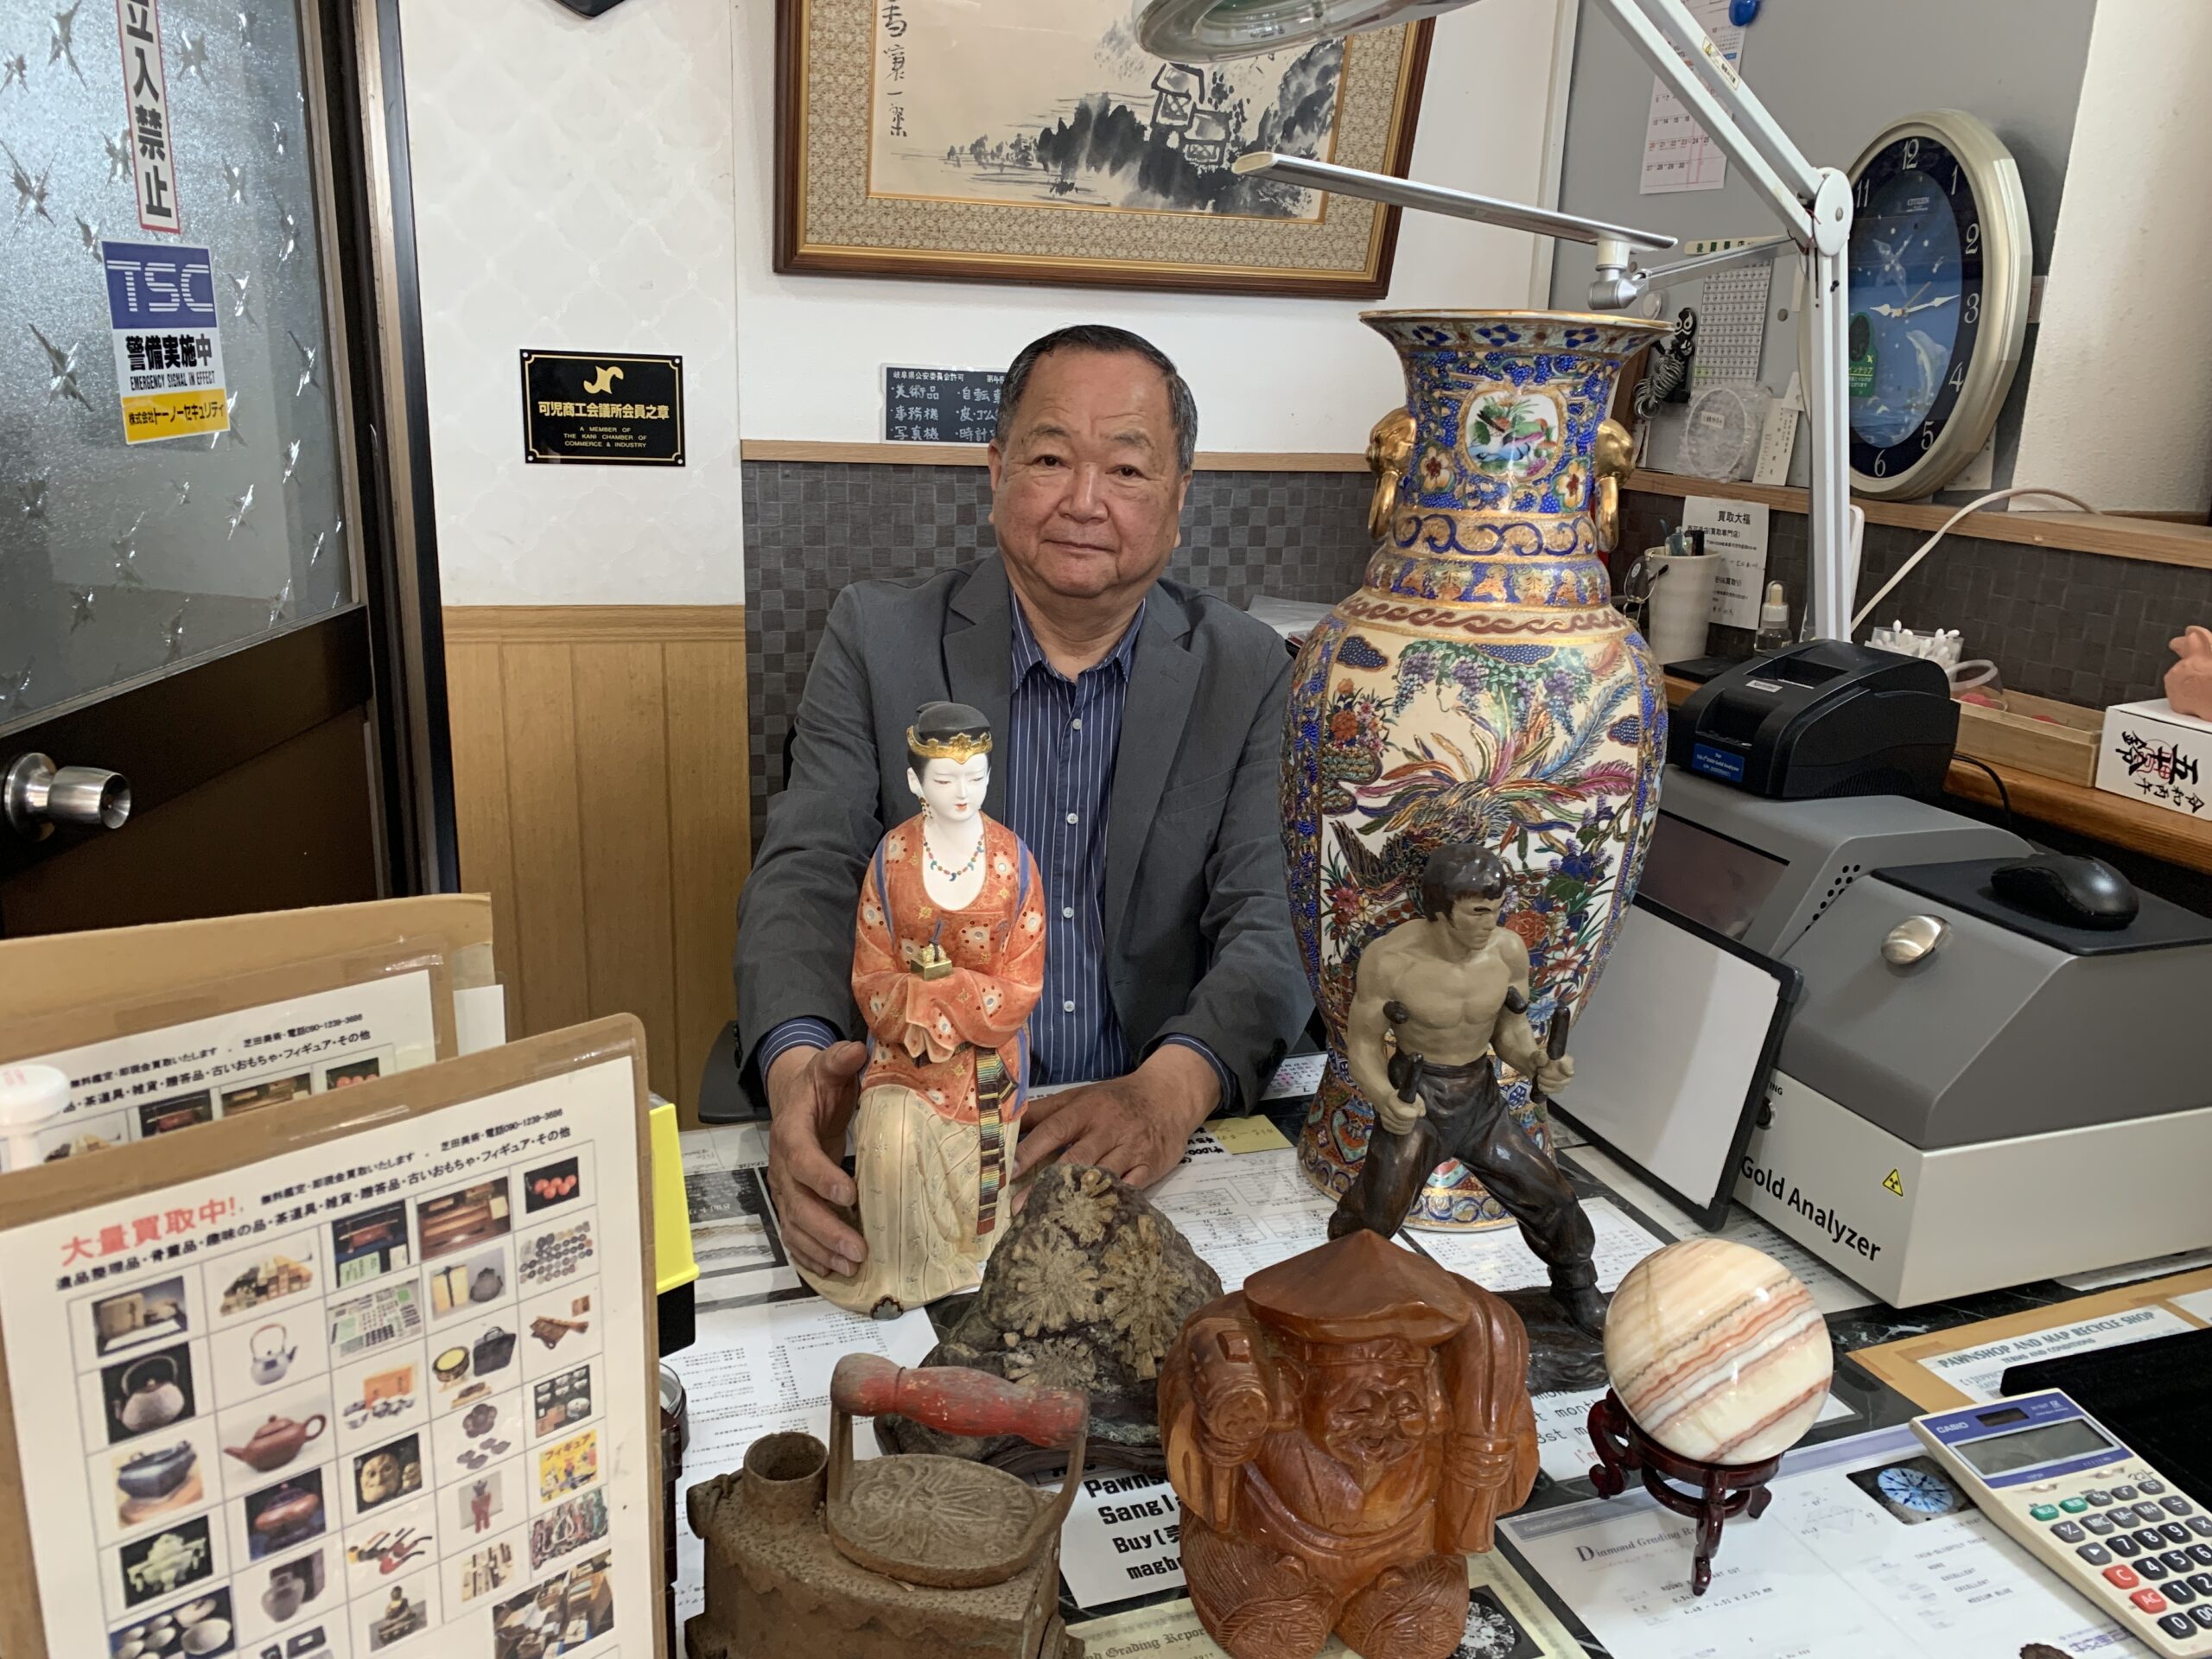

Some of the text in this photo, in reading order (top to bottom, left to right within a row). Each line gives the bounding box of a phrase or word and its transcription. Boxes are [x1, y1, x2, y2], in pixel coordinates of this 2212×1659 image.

[1902, 138, 1920, 170] 12
[1856, 178, 1870, 208] 11
[1950, 164, 1959, 195] 1
[1965, 223, 1980, 255] 2
[106, 260, 214, 312] TSC
[1963, 293, 1980, 324] 3
[125, 333, 213, 372] 警備実施中
[130, 371, 215, 391] EMERGENCY SIGNAL IN EFFECT
[1948, 361, 1964, 392] 4
[894, 383, 939, 401] 美術品
[128, 402, 225, 426] 株式会社トーノーセキュリティ
[537, 401, 670, 420] 可児商工会議所会員之章
[894, 404, 939, 422] 事務機
[894, 425, 939, 441] 写真機
[1921, 421, 1935, 450] 5
[1874, 448, 1886, 477] 6
[1741, 1155, 1881, 1262] Gold Analyzer
[60, 1196, 237, 1268] 大量買取中!
[1937, 1345, 2012, 1369] PAWNSHOP
[2013, 1338, 2043, 1351] AND
[2042, 1332, 2070, 1344] MAP
[2071, 1319, 2125, 1337] RECYCLE
[2123, 1311, 2155, 1325] SHOP
[1554, 1399, 1596, 1418] mont
[1936, 1421, 1969, 1434] CASIO
[1574, 1541, 1636, 1562] Diamond
[1637, 1531, 1681, 1547] Grading
[2116, 1538, 2131, 1550] 7
[2143, 1531, 2159, 1542] 8
[2168, 1525, 2183, 1537] 9
[2147, 1547, 2211, 1572] 4 5 6
[2116, 1569, 2133, 1581] C
[2172, 1575, 2212, 1596] 1 2
[2140, 1592, 2162, 1605] AC
[2171, 1616, 2187, 1630] 0
[1105, 1638, 1160, 1659] Grading
[1164, 1628, 1206, 1644] Repor
